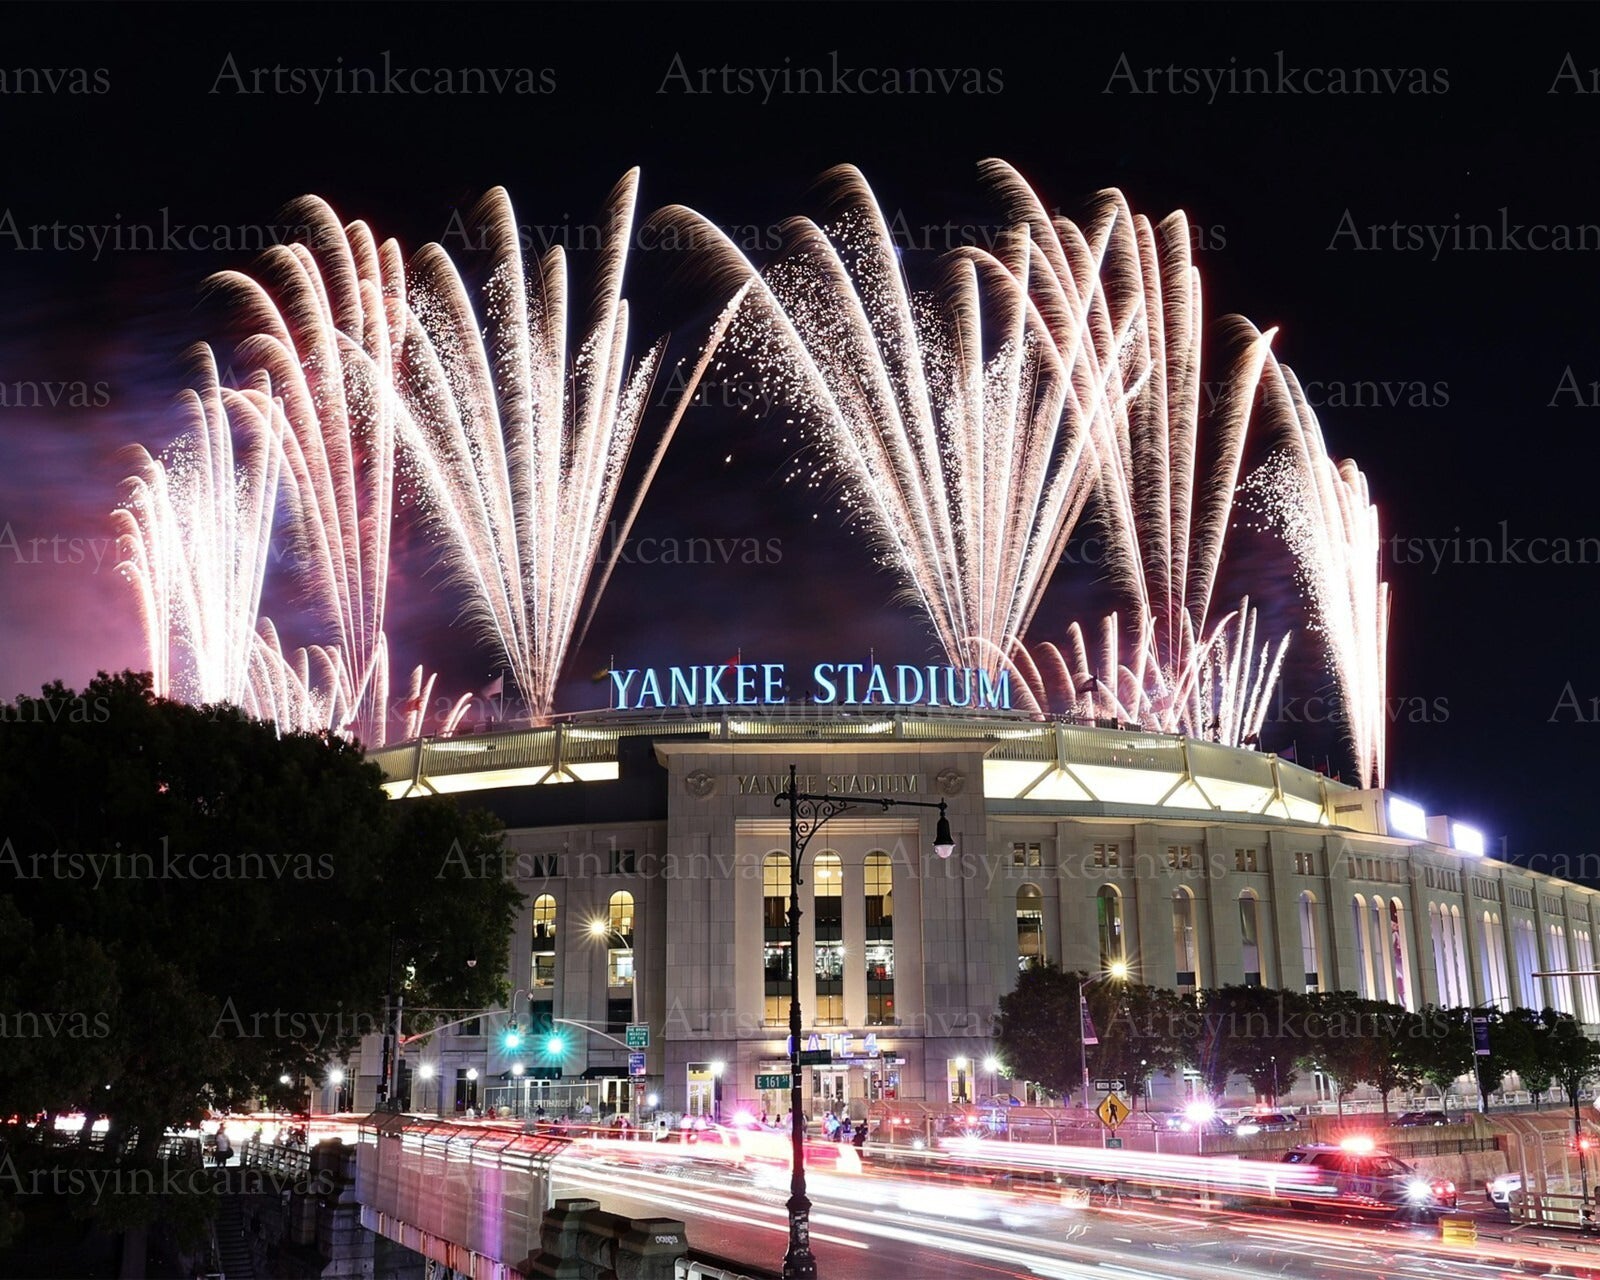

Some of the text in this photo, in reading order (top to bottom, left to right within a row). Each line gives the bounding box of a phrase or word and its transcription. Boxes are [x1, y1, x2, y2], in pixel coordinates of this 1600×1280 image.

[607, 663, 787, 710] YANKEE
[812, 662, 1011, 710] STADIUM
[736, 774, 919, 795] YANKEE STADIUM
[863, 1033, 880, 1058] 4
[757, 1076, 763, 1088] E
[766, 1076, 780, 1088] 161
